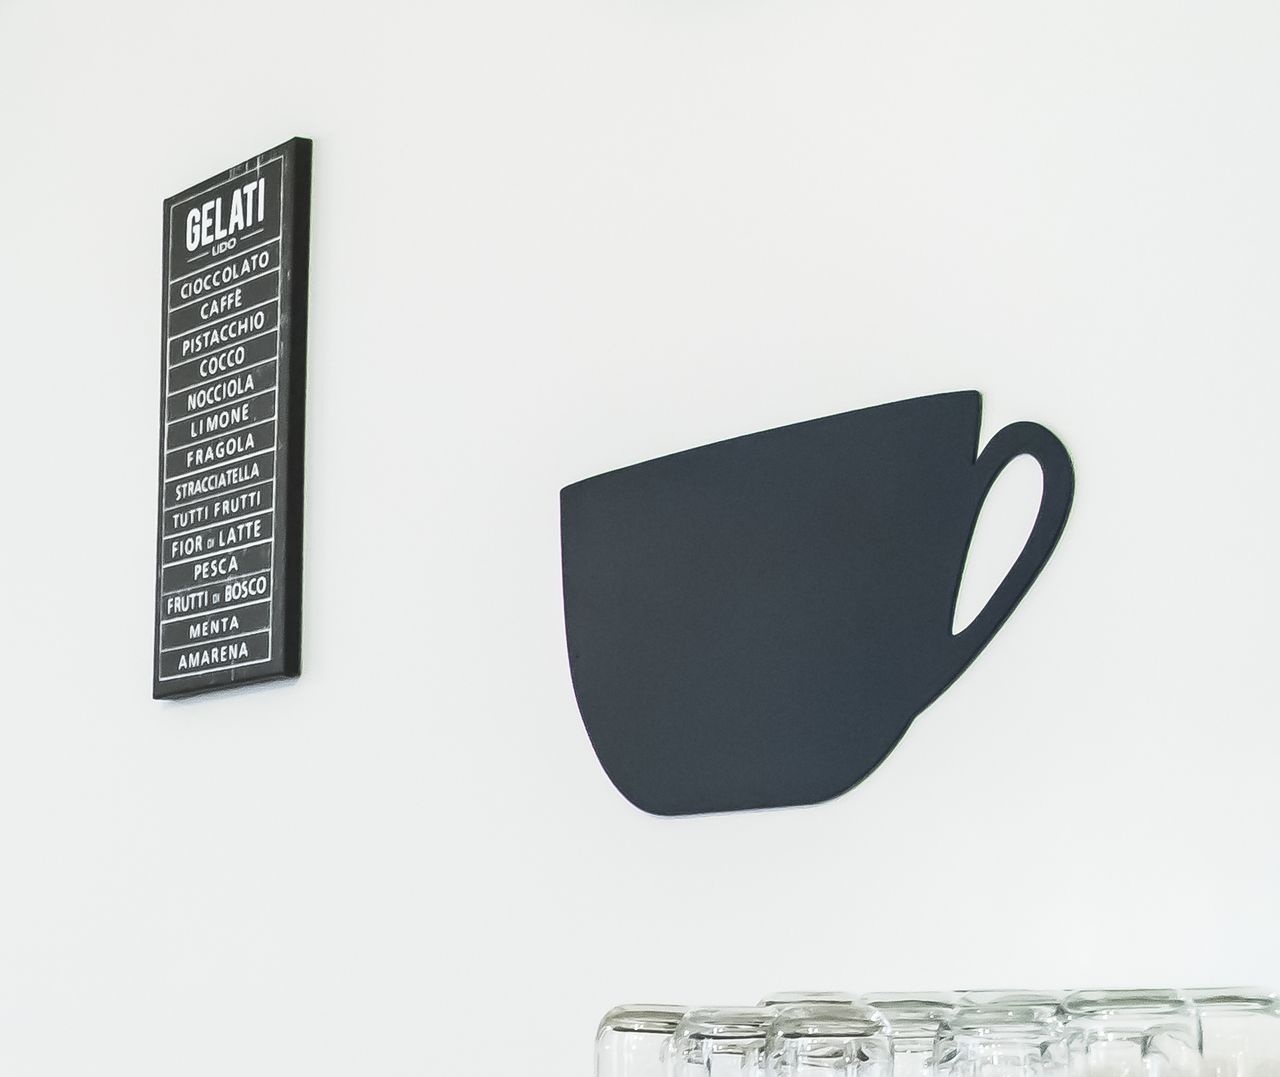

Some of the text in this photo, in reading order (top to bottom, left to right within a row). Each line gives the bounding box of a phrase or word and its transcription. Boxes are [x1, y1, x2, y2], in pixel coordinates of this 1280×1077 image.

[186, 178, 265, 251] GELATI
[180, 250, 270, 300] CIOCCOLATO
[183, 310, 265, 357] PISTACCHIO
[199, 346, 245, 378] COCCO
[187, 374, 255, 412] NOCCIOLA
[191, 403, 250, 438] LIMONE
[186, 432, 255, 468] FRAGOLA
[175, 462, 260, 502] STRACCIATELLA
[172, 490, 261, 529] TUTTI FRUTTI
[171, 534, 203, 559] FIOR
[218, 519, 262, 548] LATTE
[193, 555, 238, 581] PESCA
[167, 590, 208, 615] FRUTTI
[224, 575, 267, 603] BOSCO
[189, 615, 239, 640] MENTA
[178, 641, 249, 671] AMARENA
